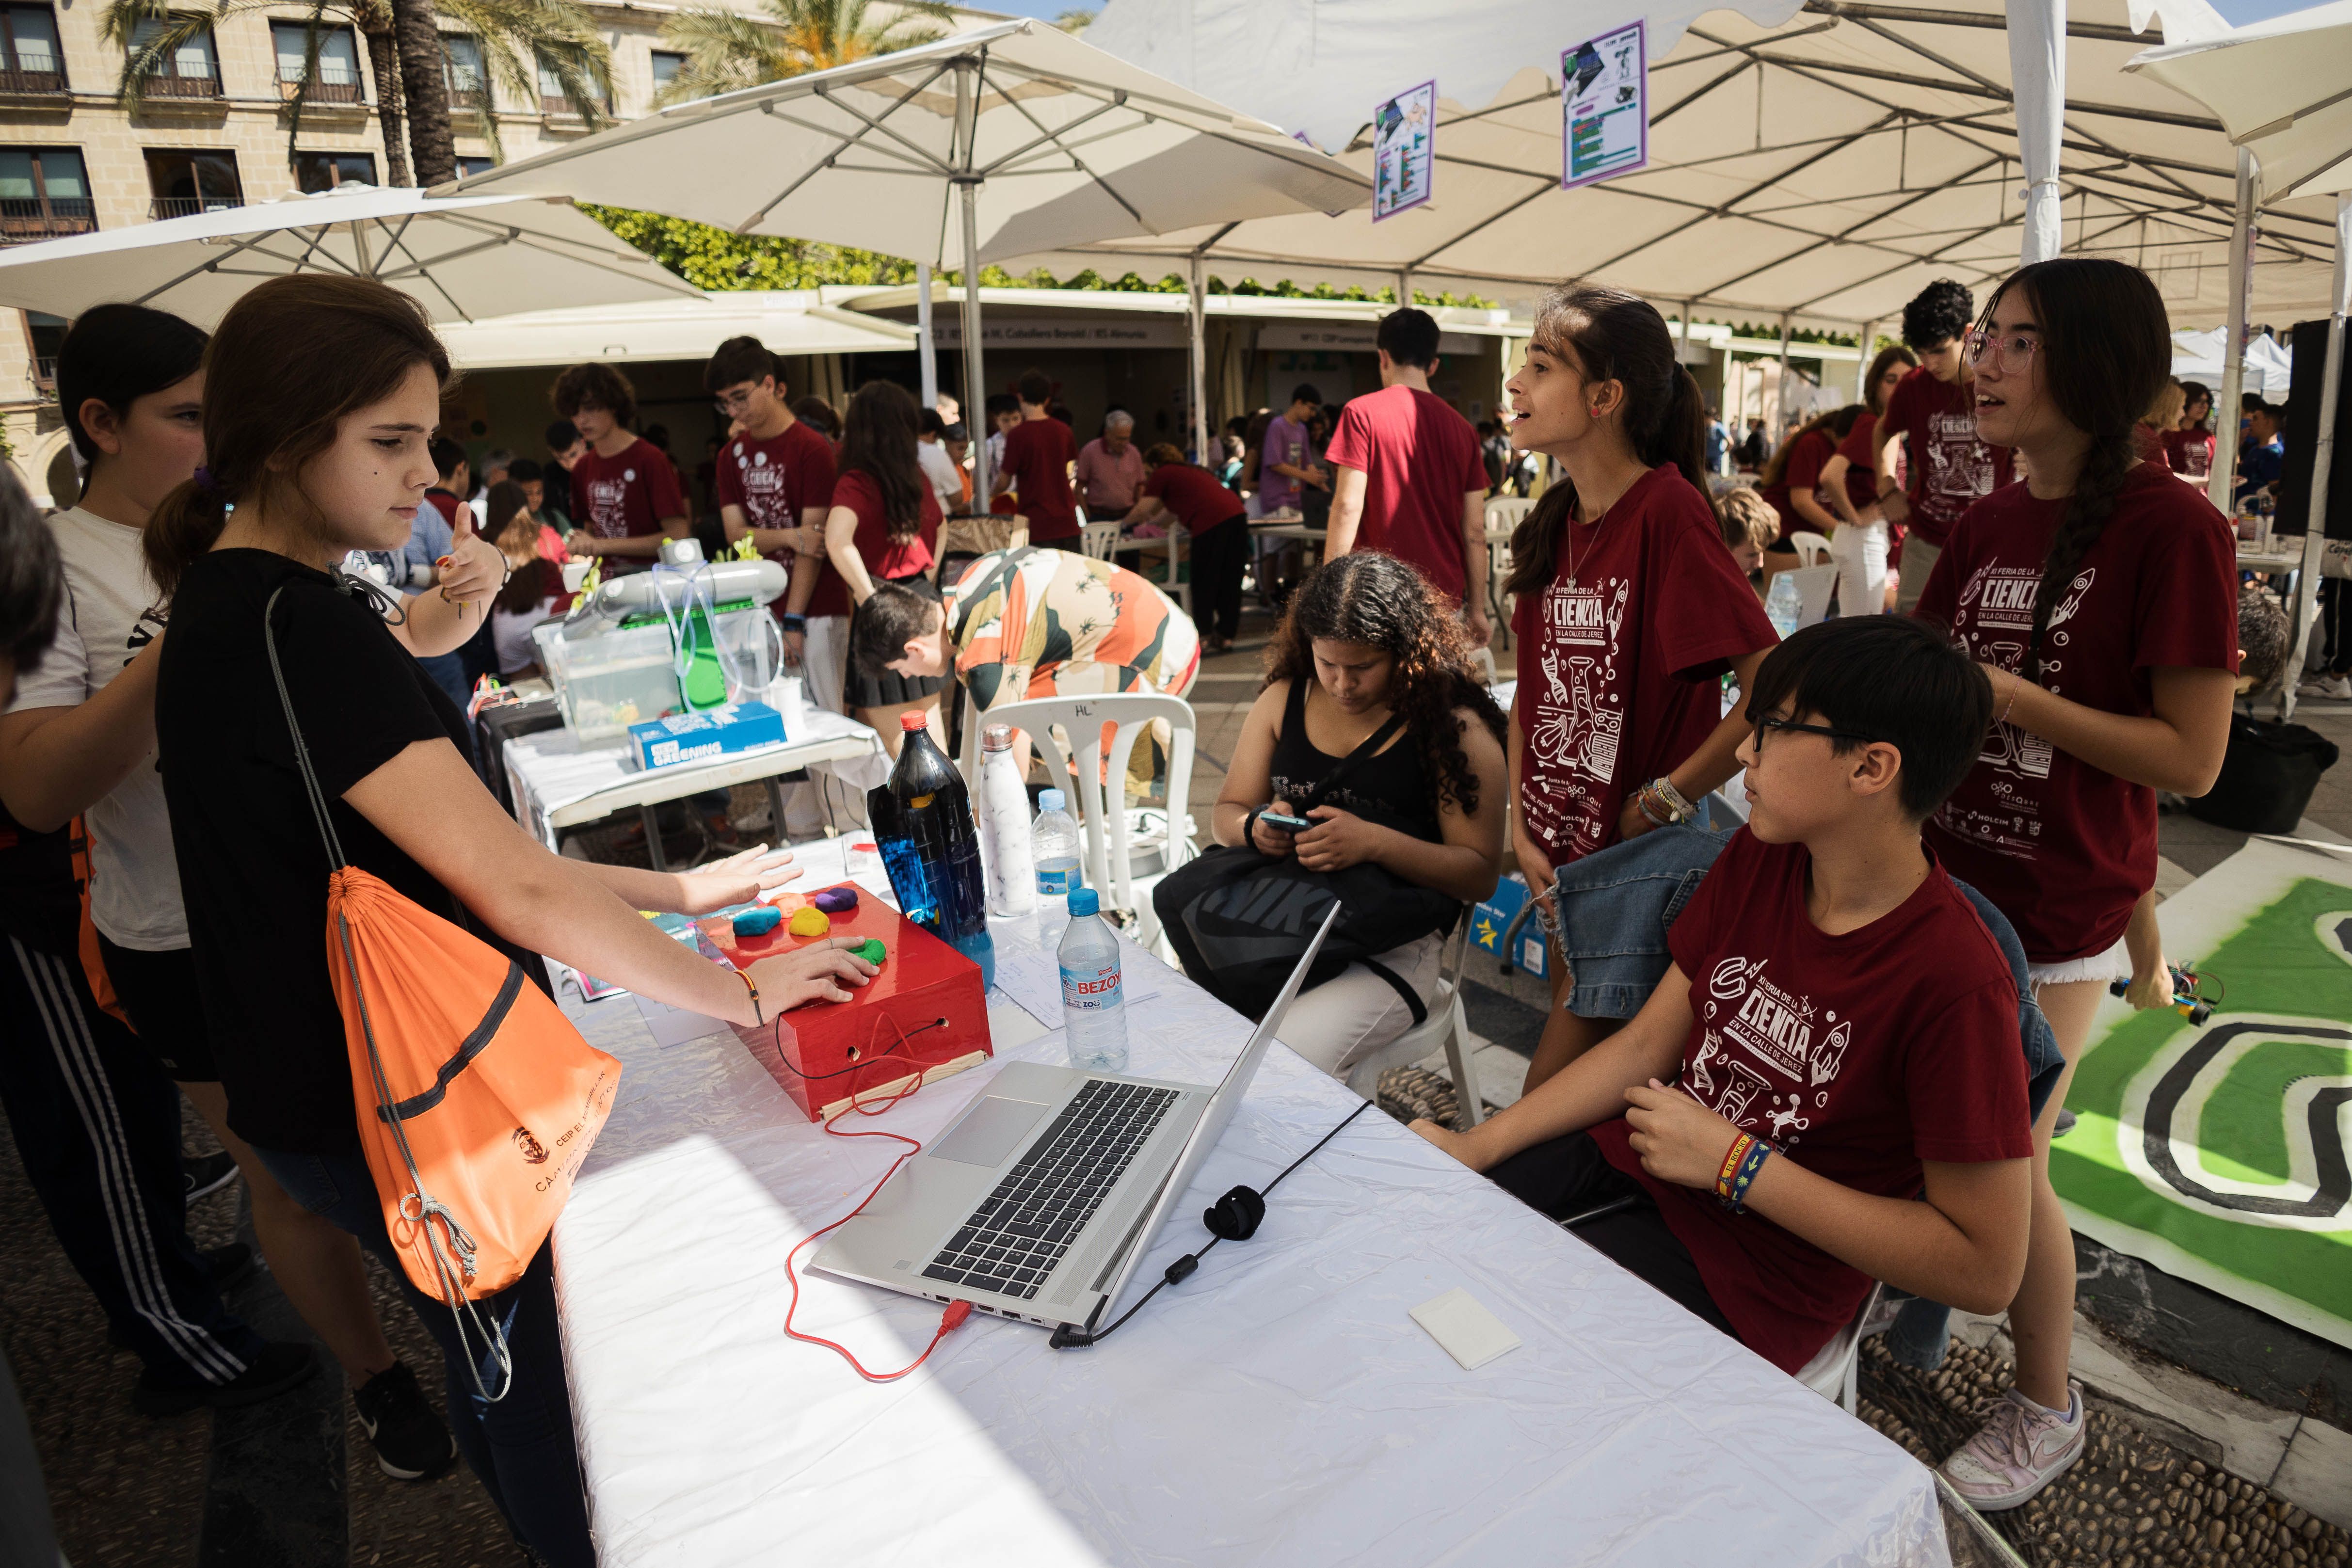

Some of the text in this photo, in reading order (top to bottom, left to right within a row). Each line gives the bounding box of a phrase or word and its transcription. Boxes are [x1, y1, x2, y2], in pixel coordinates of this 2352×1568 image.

[1981, 579, 2040, 609] CIENCI
[1554, 598, 1604, 627] CIENCIA
[1995, 613, 2012, 621] CALLE
[1075, 705, 1092, 717] HL
[1978, 814, 2009, 826] HOLCIM
[1780, 992, 1791, 1005] DE
[1791, 999, 1798, 1010] LA
[1739, 988, 1810, 1062] CIENCIA
[1728, 1020, 1803, 1074] EN LA CALLE DE JEREZ
[556, 1130, 574, 1146] CEIP
[574, 1122, 585, 1132] EL
[1726, 1140, 1747, 1172] EL ROCIO
